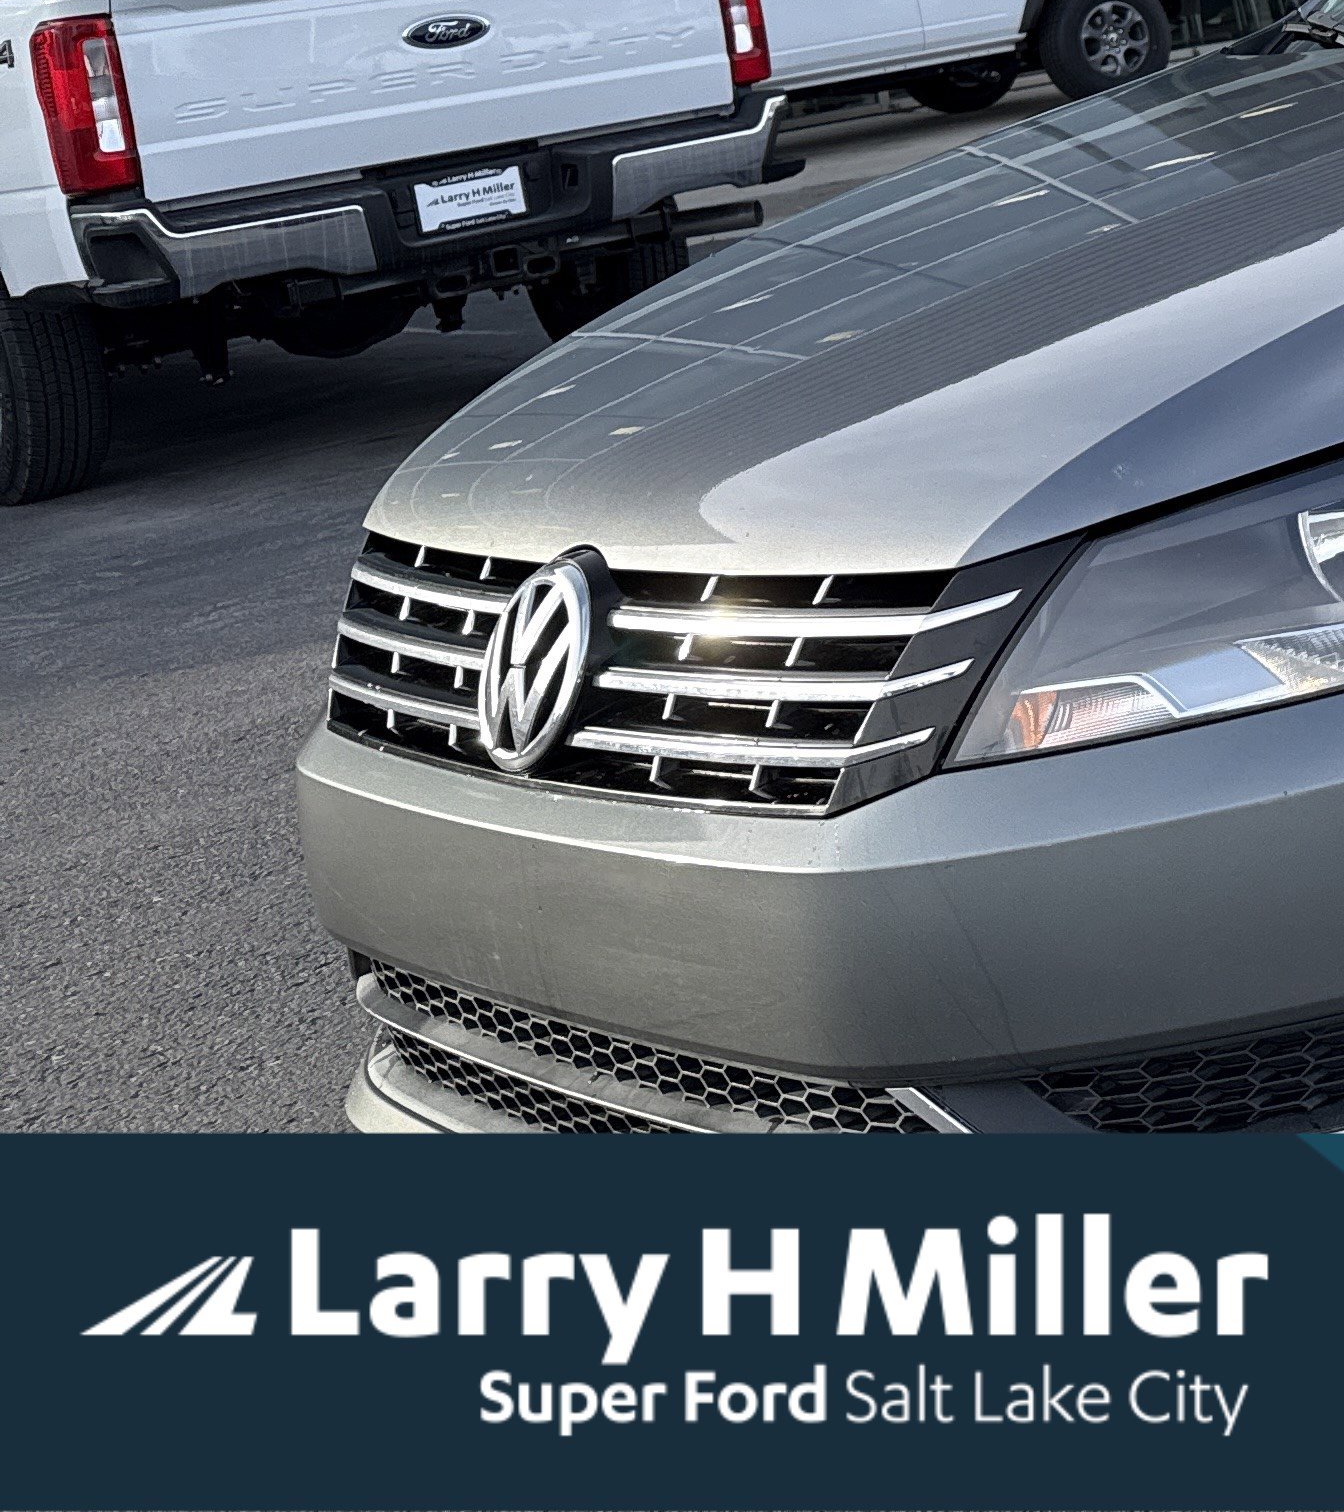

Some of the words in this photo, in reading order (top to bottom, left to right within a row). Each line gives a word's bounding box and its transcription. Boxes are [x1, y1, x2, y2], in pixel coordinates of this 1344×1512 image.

[425, 19, 473, 44] Ford
[440, 190, 470, 204] Larry
[471, 187, 482, 198] H
[482, 181, 515, 196] Miller
